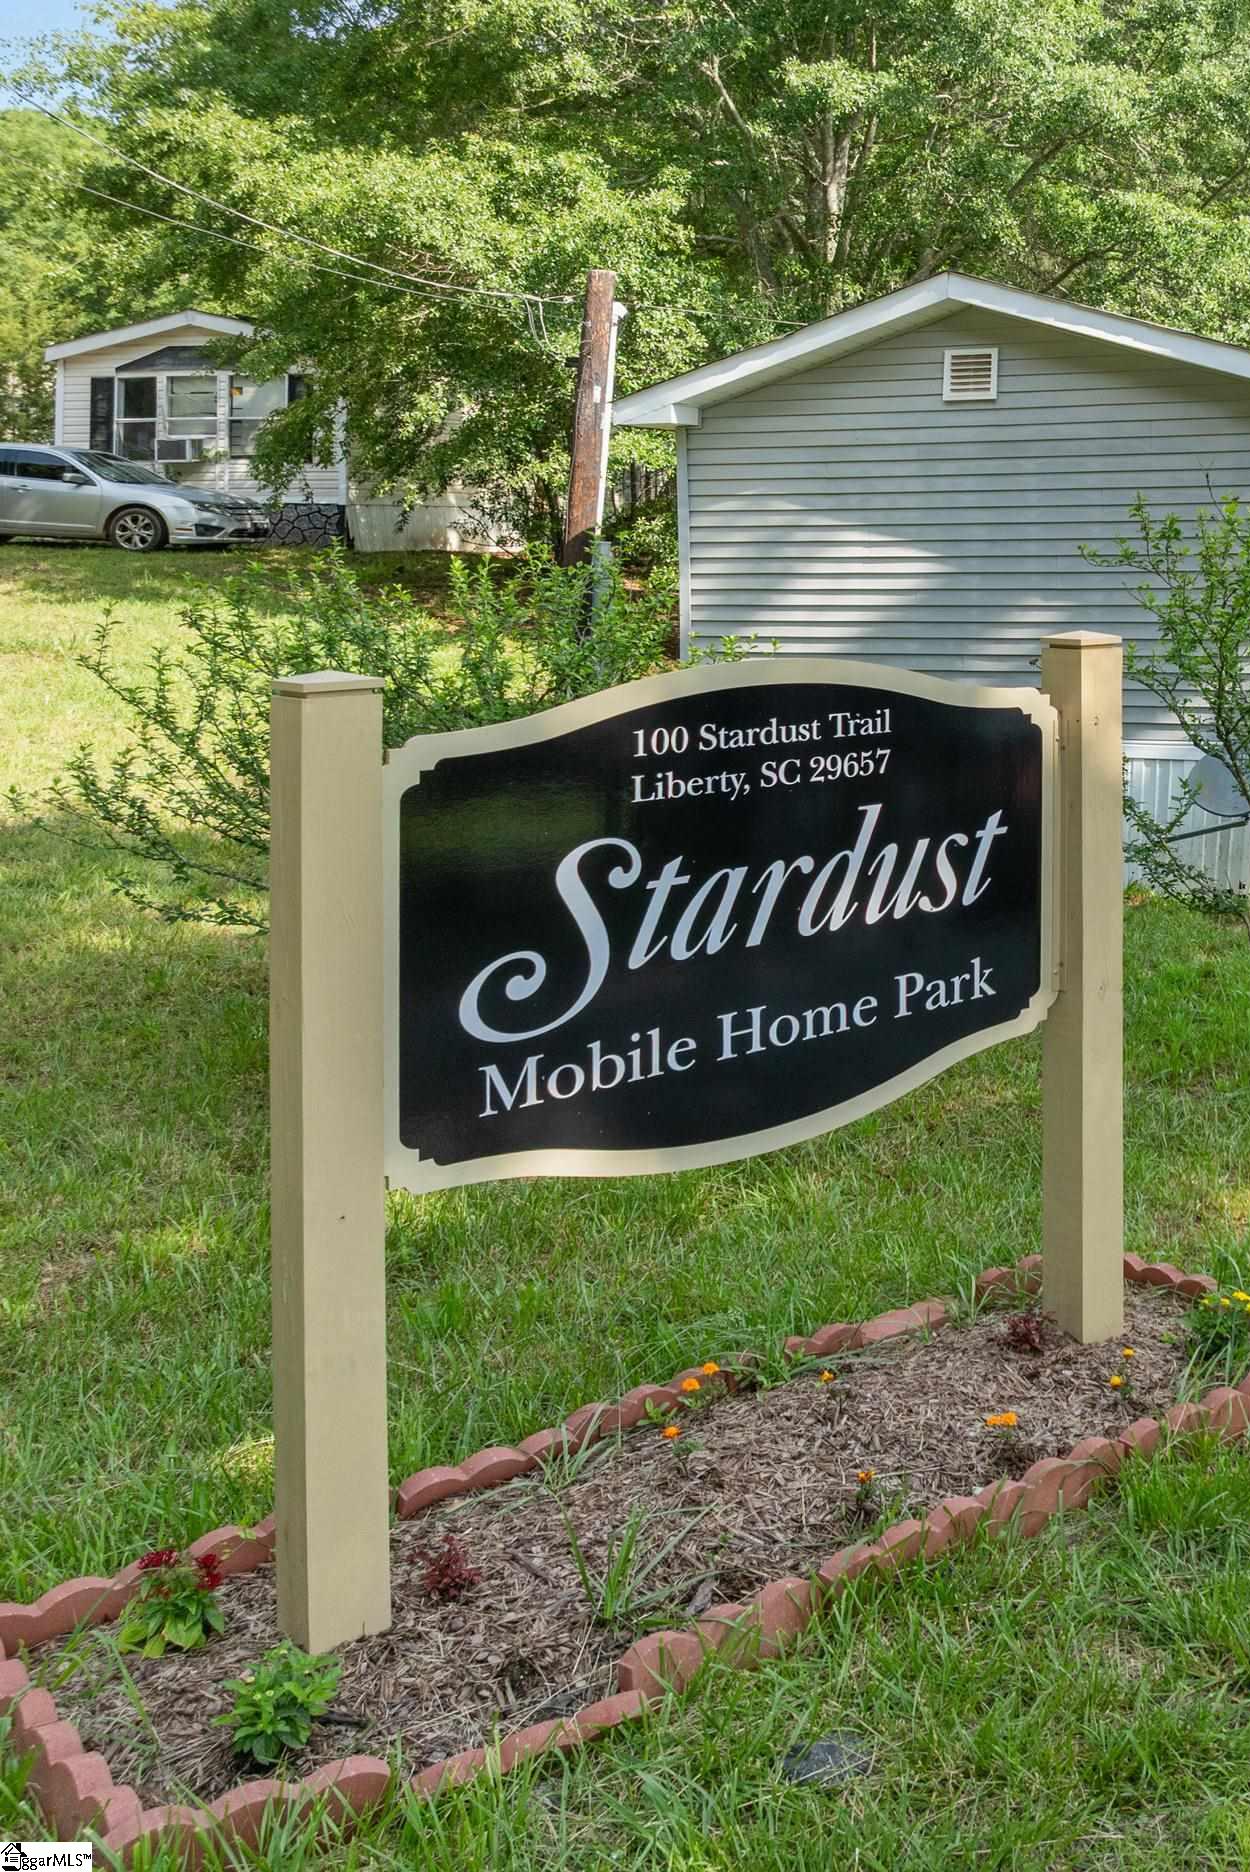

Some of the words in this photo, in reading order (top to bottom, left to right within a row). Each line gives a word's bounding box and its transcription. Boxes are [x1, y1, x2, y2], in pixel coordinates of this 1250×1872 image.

[631, 770, 752, 803] Liberty,
[760, 758, 801, 788] SC
[809, 747, 891, 783] 29657
[632, 725, 689, 758] 100
[698, 717, 822, 751] Stardust
[828, 708, 892, 738] Trail
[458, 802, 1009, 1043] Stardust
[477, 1027, 697, 1118] Mobile
[716, 995, 878, 1062] Home
[893, 956, 997, 1019] Park
